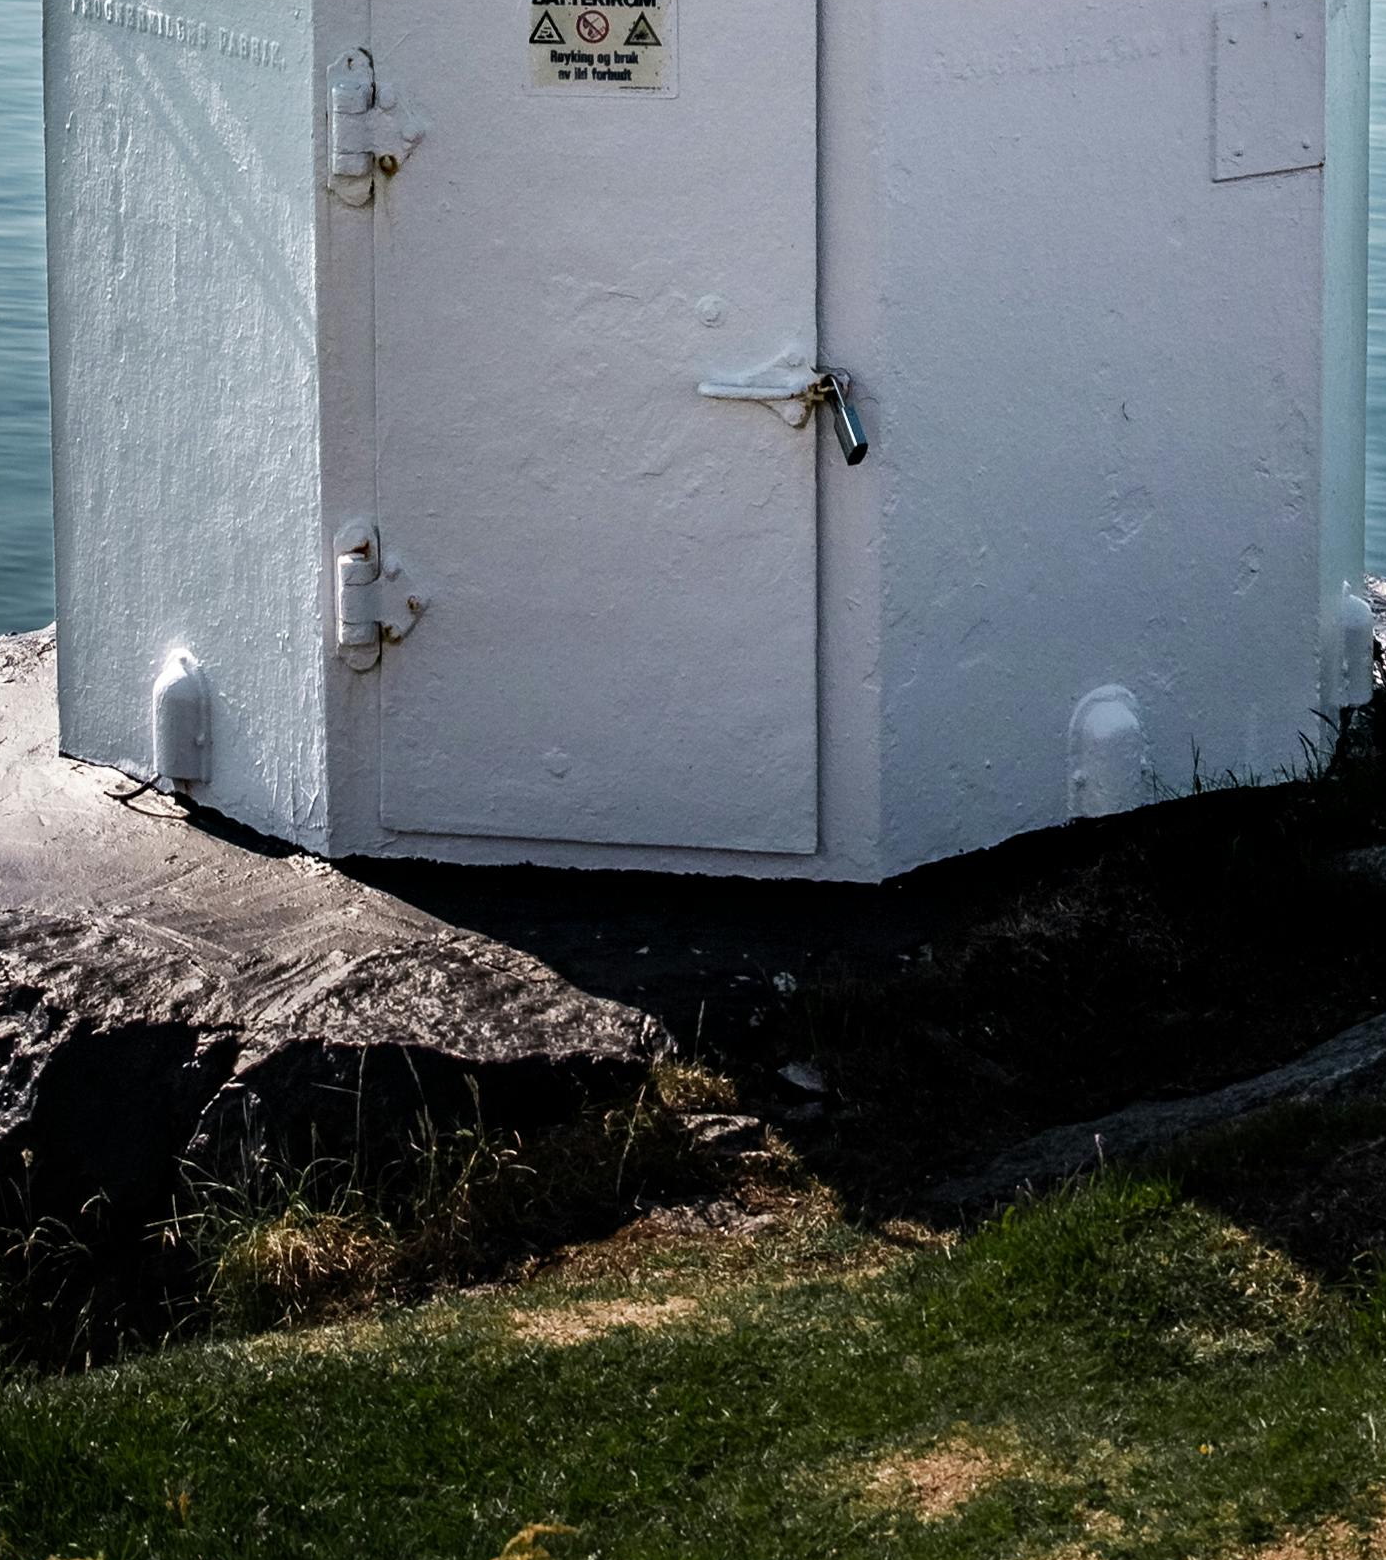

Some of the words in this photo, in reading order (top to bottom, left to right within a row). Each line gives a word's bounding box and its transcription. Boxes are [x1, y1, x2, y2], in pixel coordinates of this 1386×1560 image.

[550, 50, 594, 66] Røyking
[597, 53, 611, 67] og
[614, 50, 639, 64] bruk
[558, 69, 571, 80] av
[574, 67, 588, 80] ild
[592, 67, 632, 81] forbudt
